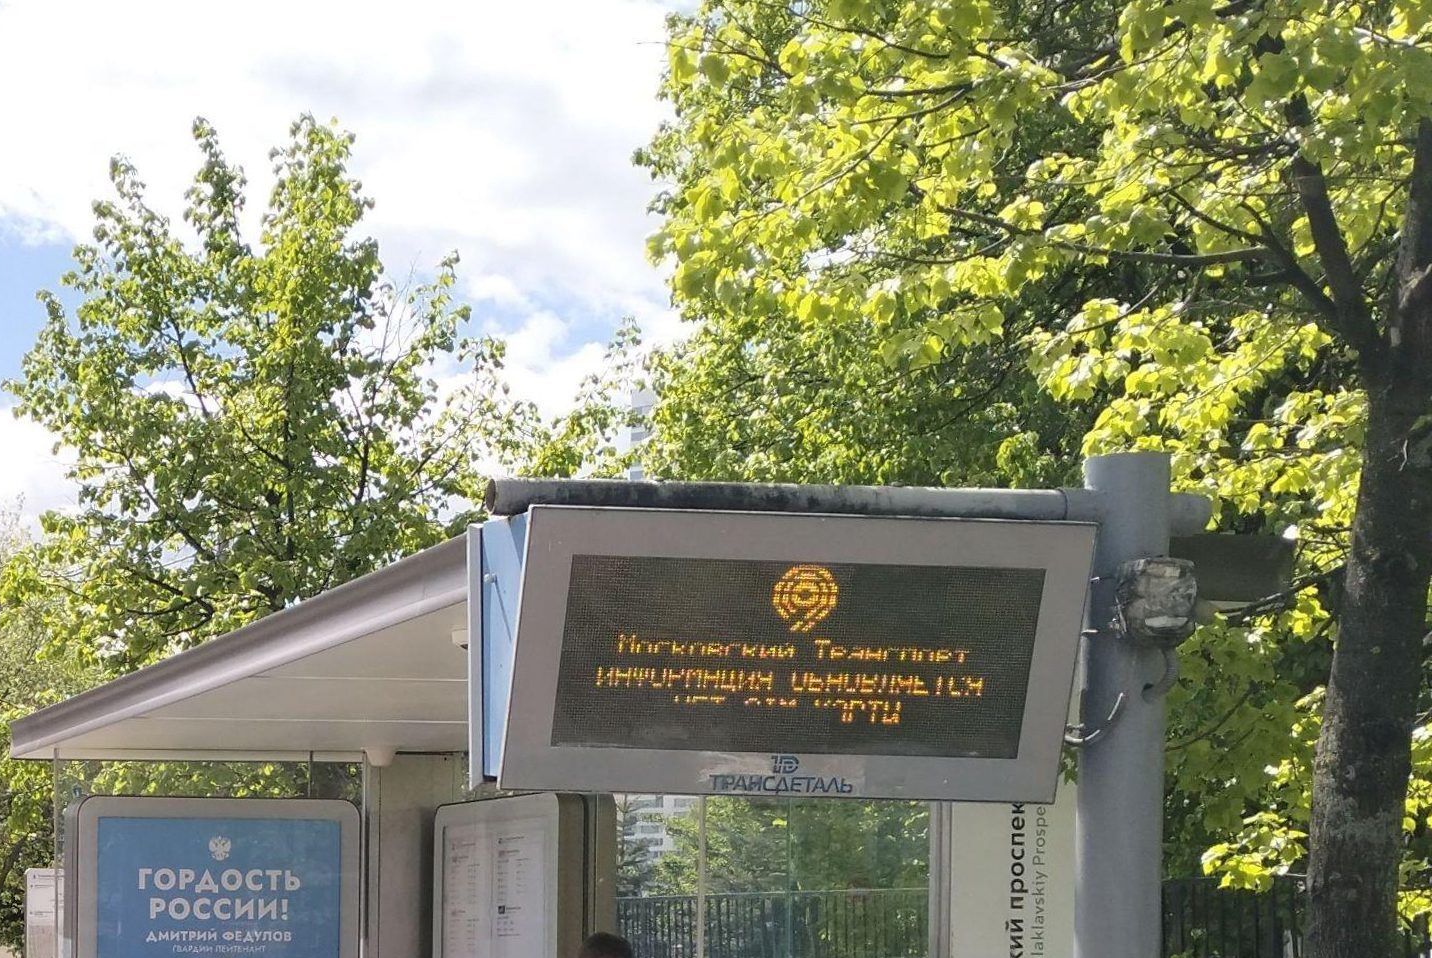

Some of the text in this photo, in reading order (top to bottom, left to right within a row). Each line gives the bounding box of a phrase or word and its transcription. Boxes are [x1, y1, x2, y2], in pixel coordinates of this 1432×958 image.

[709, 773, 853, 794] ТРАНСДЕТАЛЬ
[1032, 805, 1049, 866] Prospe
[1010, 803, 1028, 909] проспек
[138, 867, 302, 894] ГОРДОСТЬ
[149, 897, 289, 921] РОССИИ!
[145, 928, 292, 943] ДМИТРИЙ ФЕДУЛОВ
